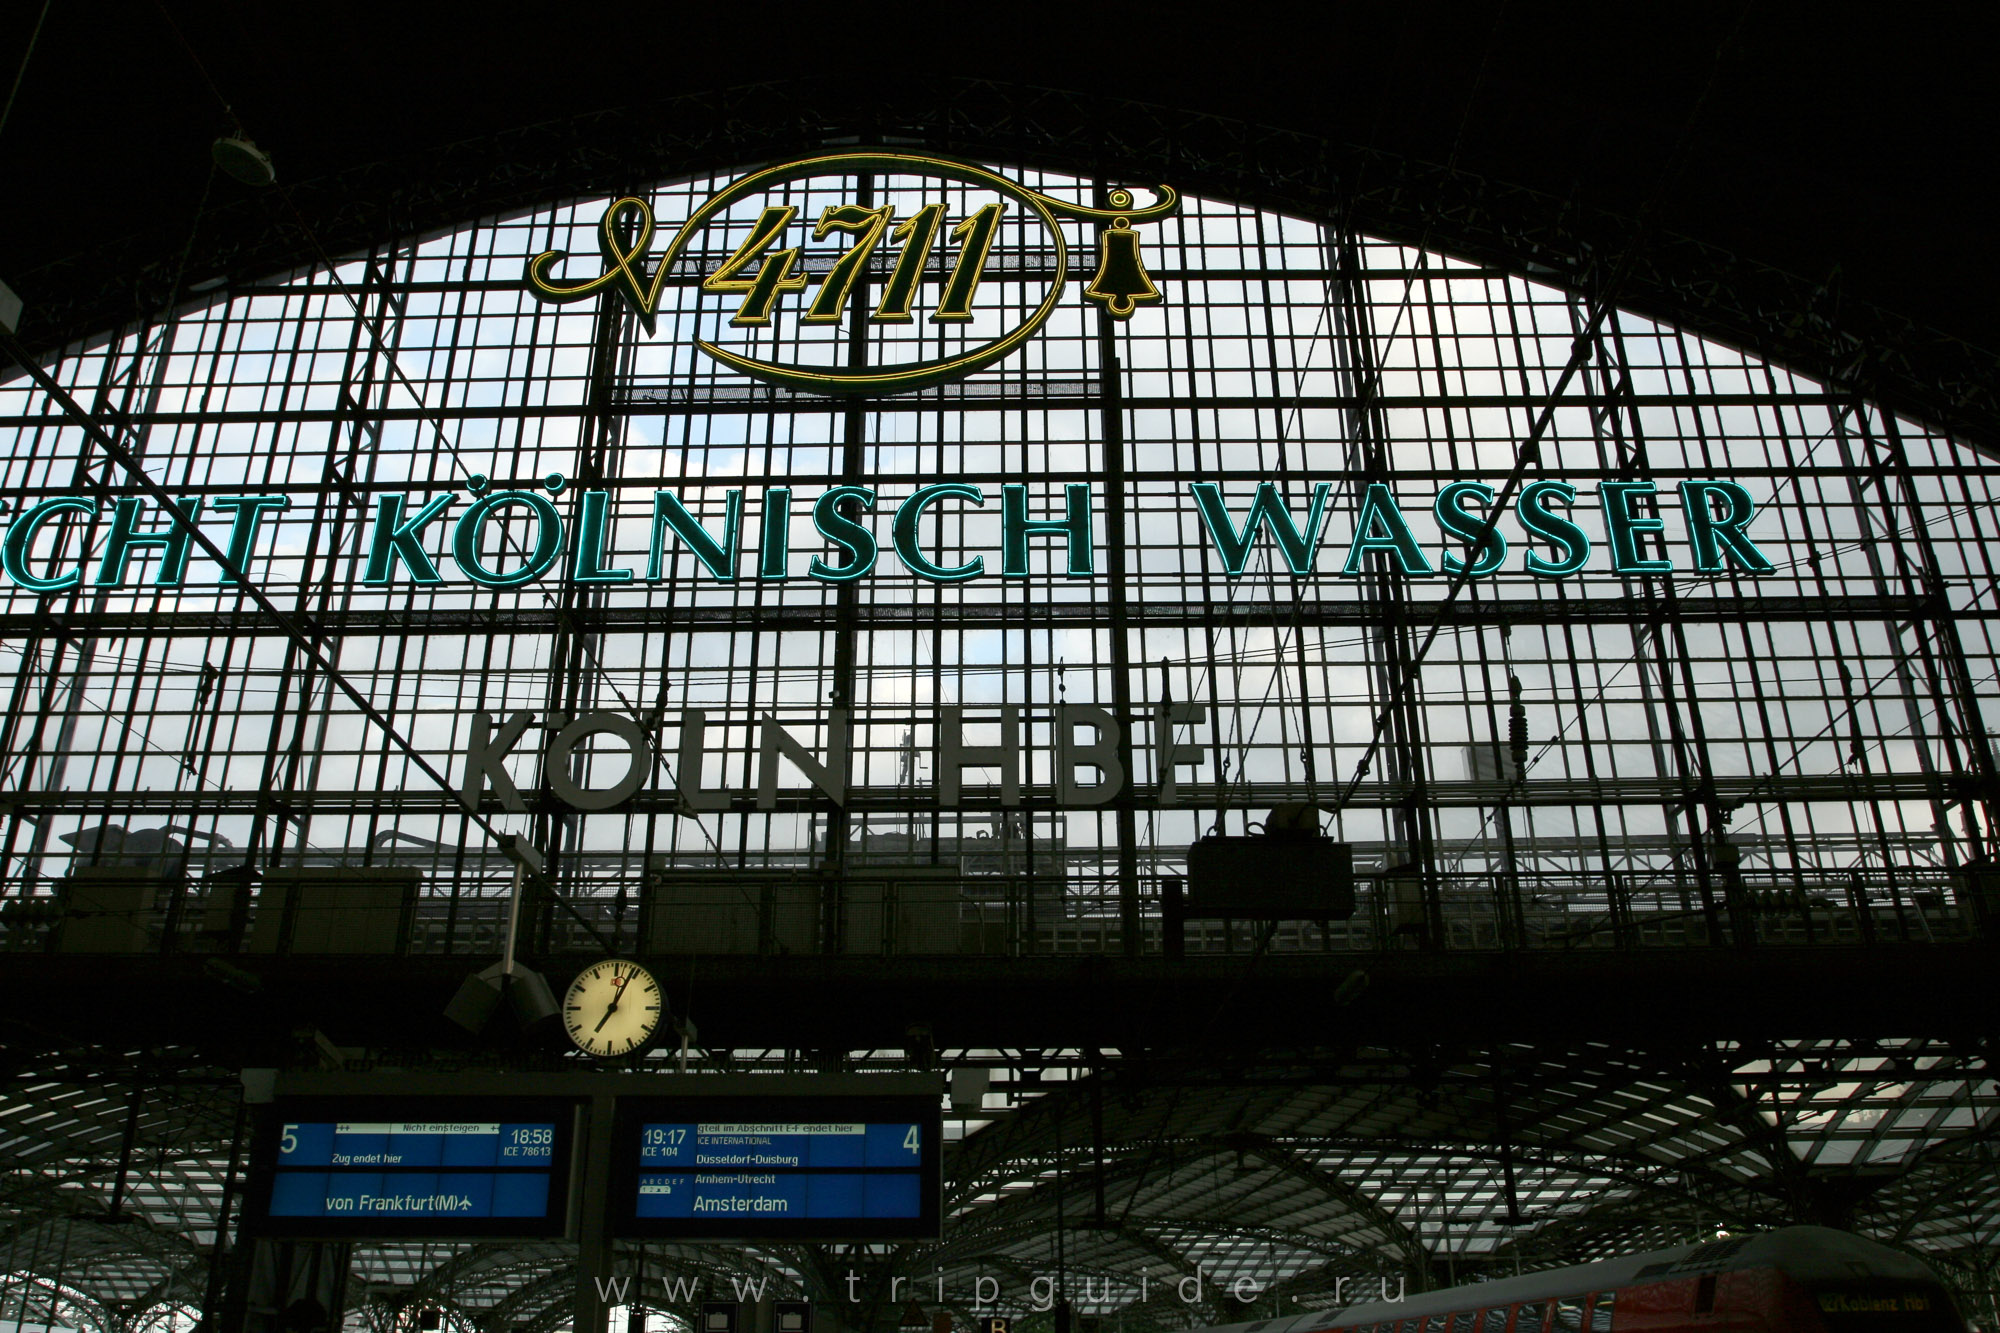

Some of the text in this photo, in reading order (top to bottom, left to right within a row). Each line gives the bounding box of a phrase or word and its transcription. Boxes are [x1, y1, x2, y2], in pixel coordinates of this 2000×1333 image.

[702, 202, 1008, 328] 4711
[0, 472, 1777, 592] CHT KÖLNISCH WASSER
[939, 703, 1206, 806] HBF
[402, 1124, 427, 1132] Nicht
[429, 1124, 480, 1134] einsteigen
[723, 1124, 734, 1132] im
[737, 1124, 783, 1132] Abschnitt
[803, 1124, 832, 1132] endet
[835, 1124, 853, 1132] hier
[279, 1124, 299, 1154] 5
[511, 1129, 553, 1145] 18:58
[643, 1129, 686, 1145] 19:17
[697, 1136, 772, 1145] ICE INTERNATIONAL
[902, 1124, 920, 1154] 4
[332, 1153, 402, 1165] Zug endet hier
[503, 1146, 551, 1156] ICE 78613
[642, 1147, 678, 1157] ICE 104
[696, 1154, 799, 1167] Düsseldorf-Duisburg
[695, 1174, 776, 1185] Arnhem-Utrecht
[326, 1195, 458, 1212] von Frankfurt(M)
[693, 1195, 788, 1213] Amsterdam
